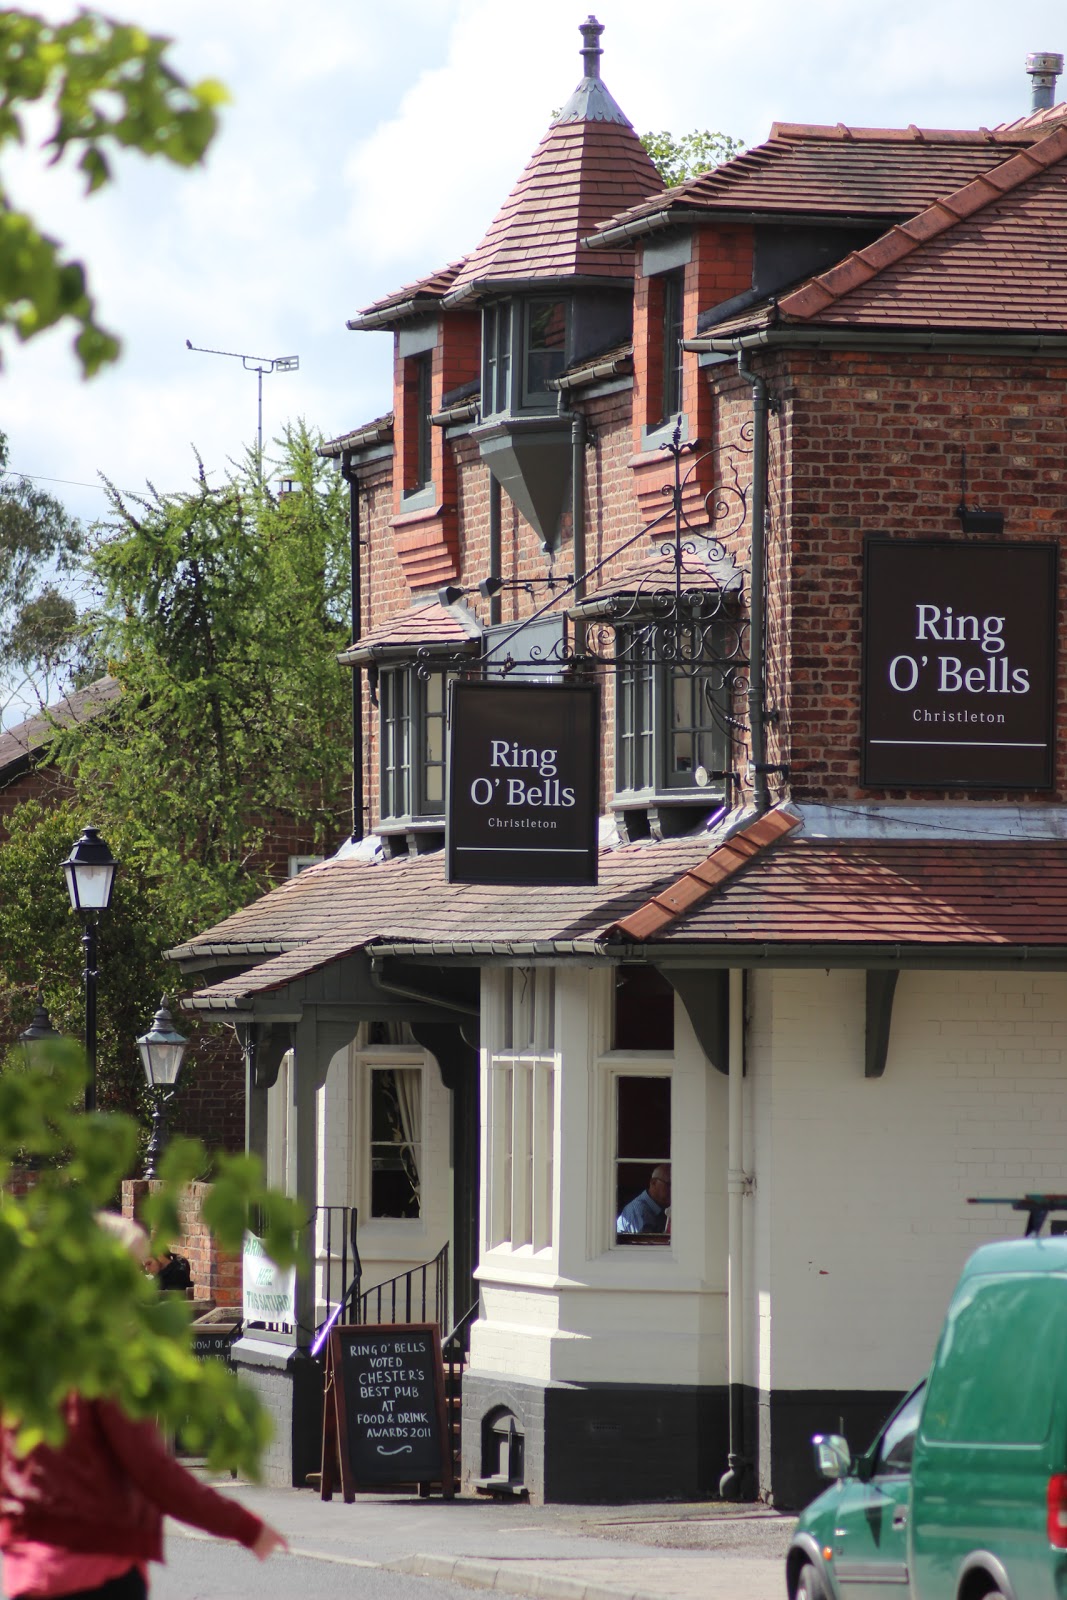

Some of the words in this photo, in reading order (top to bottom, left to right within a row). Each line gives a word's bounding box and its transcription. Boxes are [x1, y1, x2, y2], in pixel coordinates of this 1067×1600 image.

[915, 604, 1006, 653] Ring
[937, 656, 1031, 694] Bells
[913, 709, 1006, 723] Christleton
[490, 740, 558, 777] Ring
[506, 778, 576, 807] Bells
[488, 817, 557, 829] Christleton
[190, 1340, 211, 1350] NOW
[350, 1345, 378, 1357] RING
[394, 1342, 426, 1353] BELLS
[369, 1357, 403, 1368] VOTED
[358, 1368, 425, 1385] CHESTER'S
[360, 1386, 390, 1398] BEST
[394, 1386, 419, 1398] PUB
[381, 1400, 396, 1412] AT
[357, 1413, 385, 1424] FOOD
[386, 1413, 395, 1424] &
[397, 1412, 429, 1424] DRINK
[366, 1427, 408, 1438] AWARDS
[410, 1427, 431, 1438] 2011
